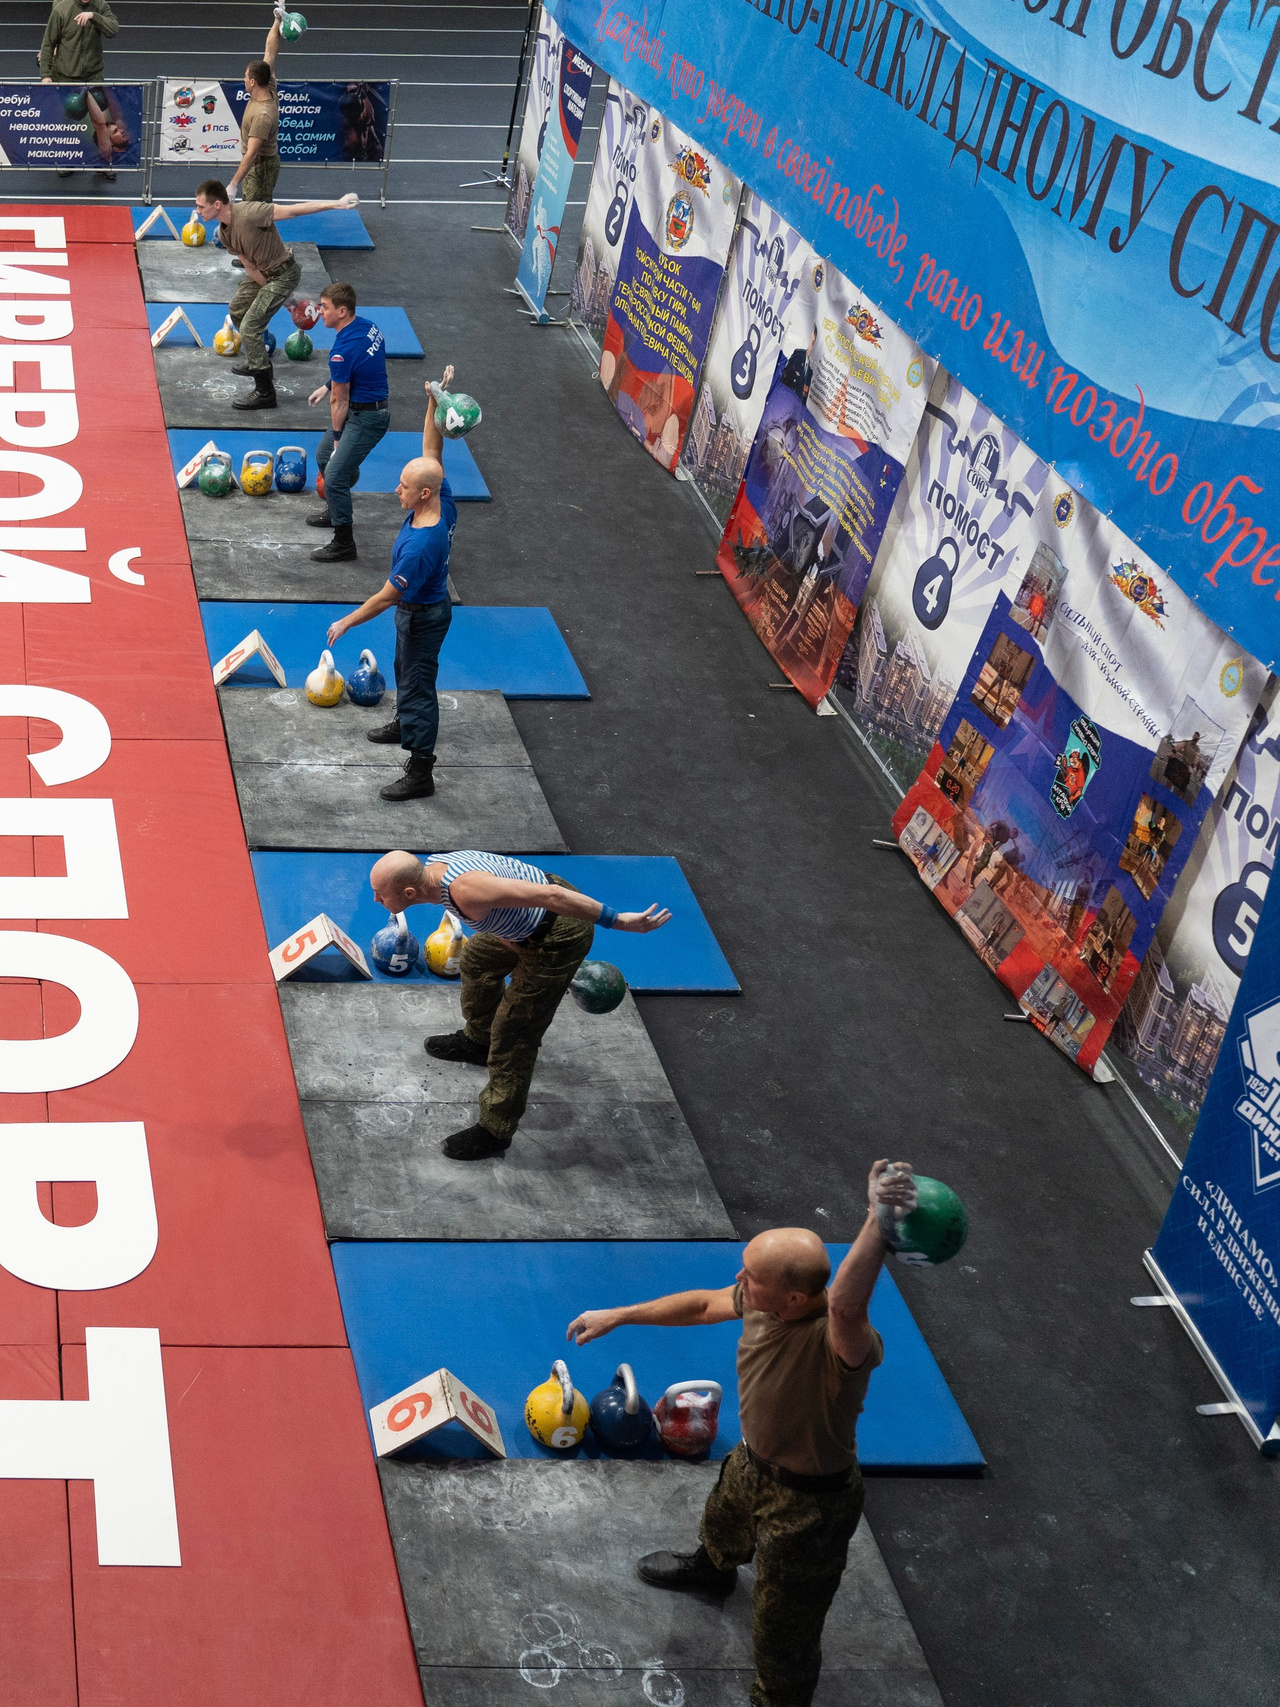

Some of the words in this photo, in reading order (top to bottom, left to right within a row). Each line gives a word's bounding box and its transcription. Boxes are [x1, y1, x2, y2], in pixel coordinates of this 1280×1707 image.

[235, 90, 251, 102] Вс
[277, 91, 311, 102] беды,
[0, 109, 13, 118] от
[14, 107, 41, 118] себя
[278, 105, 321, 114] наются
[9, 122, 88, 133] невозможного
[277, 118, 314, 129] обеды
[744, 0, 1176, 253] О-ПРИКЛАДНОМУ
[19, 136, 28, 145] и
[29, 135, 81, 147] получишь
[277, 133, 292, 143] ад
[295, 132, 336, 142] самим
[280, 143, 318, 155] собой
[27, 150, 84, 160] максимум
[608, 205, 621, 235] 2
[189, 233, 198, 245] 1
[663, 274, 689, 298] ЧАСТИ
[667, 52, 705, 100] кто
[697, 79, 763, 148] уверен
[763, 126, 778, 158] в
[776, 139, 834, 206] своей
[825, 182, 908, 284] победе,
[904, 253, 982, 332] рано
[983, 311, 1047, 390] или
[1046, 365, 1179, 497] поздно
[741, 278, 785, 344] ПОМОСТ
[156, 317, 174, 340] 2
[669, 314, 694, 345] ПАМЯТИ
[222, 340, 235, 354] 2
[734, 350, 751, 386] 3
[445, 406, 466, 431] 4
[966, 469, 990, 498] СОЮЗ
[927, 478, 1005, 571] ПОМОСТ
[923, 574, 944, 614] 4
[1060, 601, 1102, 647] СИЛЬНЫЙ
[220, 648, 245, 674] 4
[1228, 900, 1261, 957] 5
[282, 929, 318, 964] 5
[388, 953, 410, 974] 5
[444, 957, 461, 976] 5
[1246, 1074, 1269, 1098] 1923
[1182, 1174, 1216, 1223] СИЛА
[1215, 1218, 1226, 1235] В
[1204, 1179, 1279, 1290] «ДИНАМО»
[1196, 1214, 1208, 1231] И
[1206, 1232, 1265, 1322] ЕДИНСТВЕ
[386, 1391, 433, 1433] 6
[550, 1425, 578, 1449] 6
